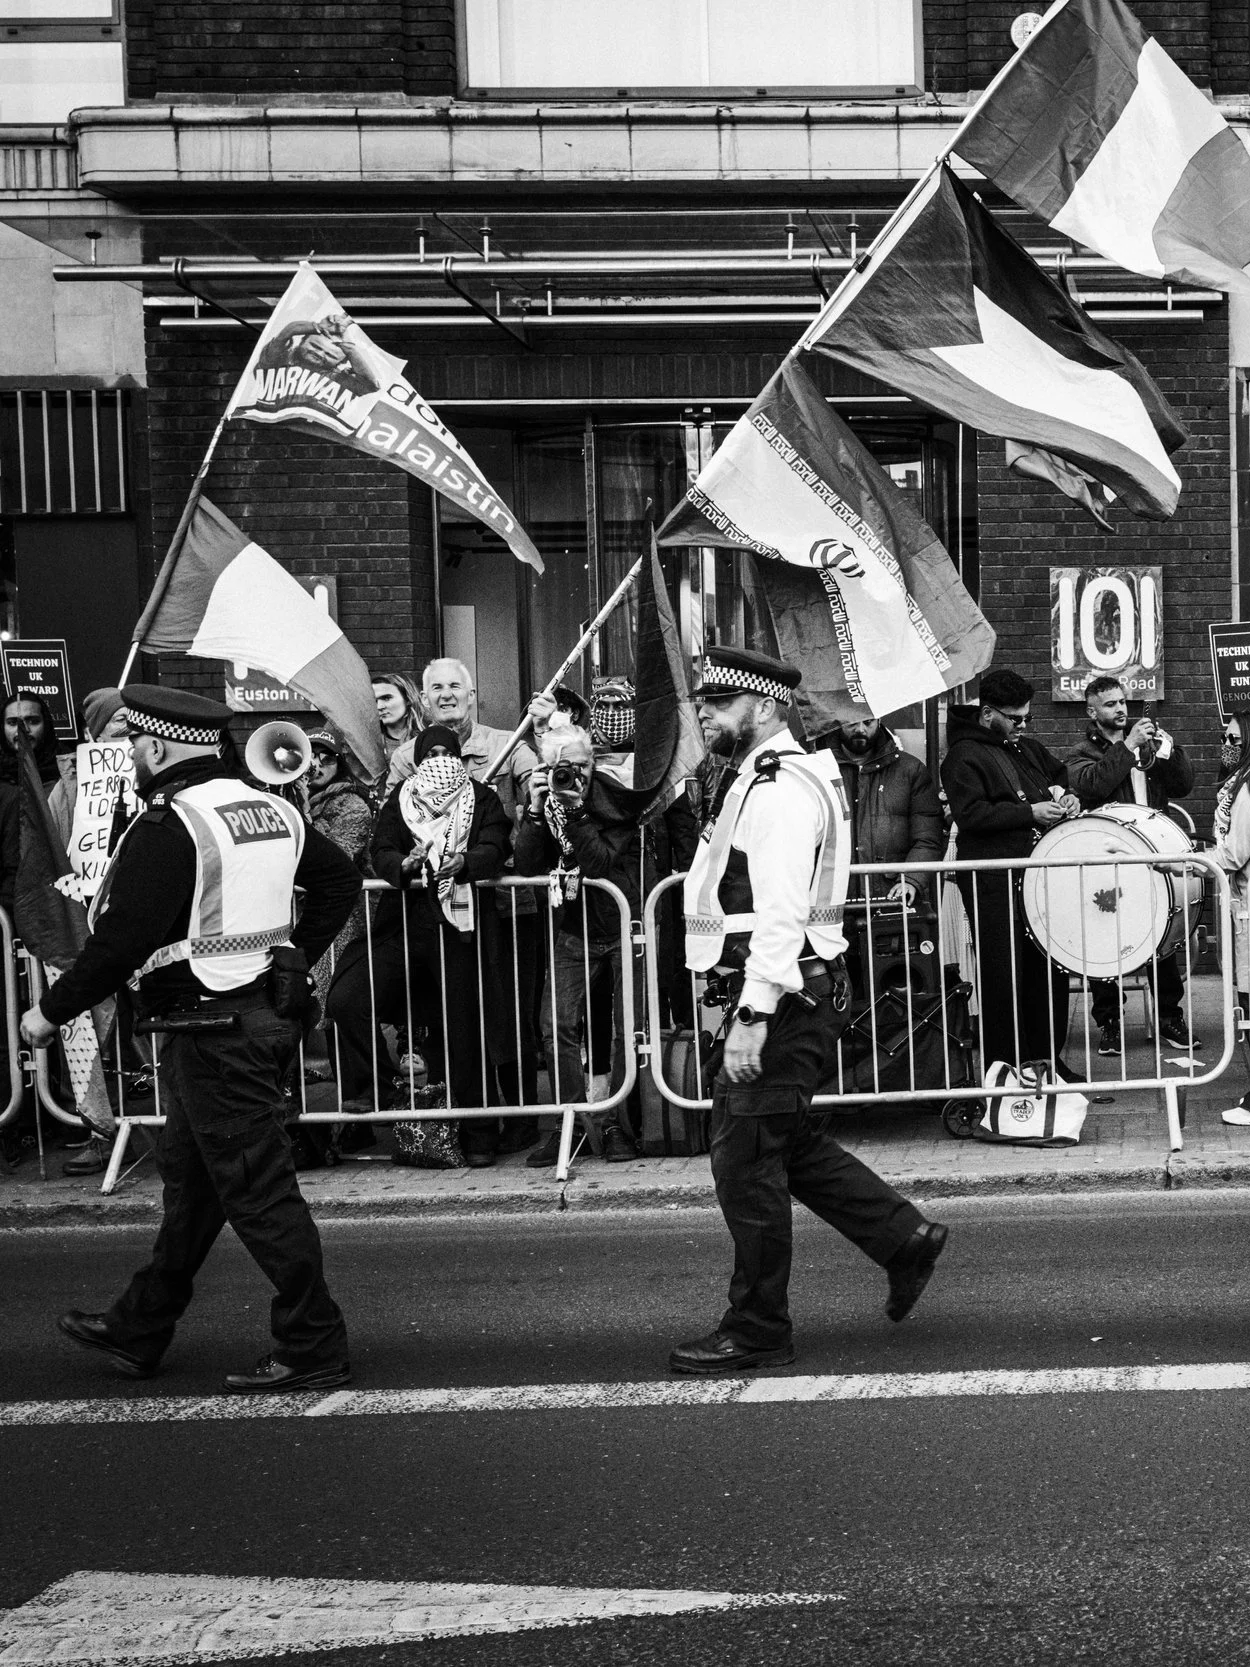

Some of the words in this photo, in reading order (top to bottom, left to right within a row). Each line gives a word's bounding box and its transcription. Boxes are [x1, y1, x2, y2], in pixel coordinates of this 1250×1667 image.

[255, 366, 360, 412] MARWAN
[1059, 575, 1156, 670] 101
[9, 658, 59, 667] TECHNION
[1235, 661, 1250, 671] UK
[28, 672, 43, 681] UK
[234, 687, 289, 701] Euston
[224, 806, 286, 837] POLICE
